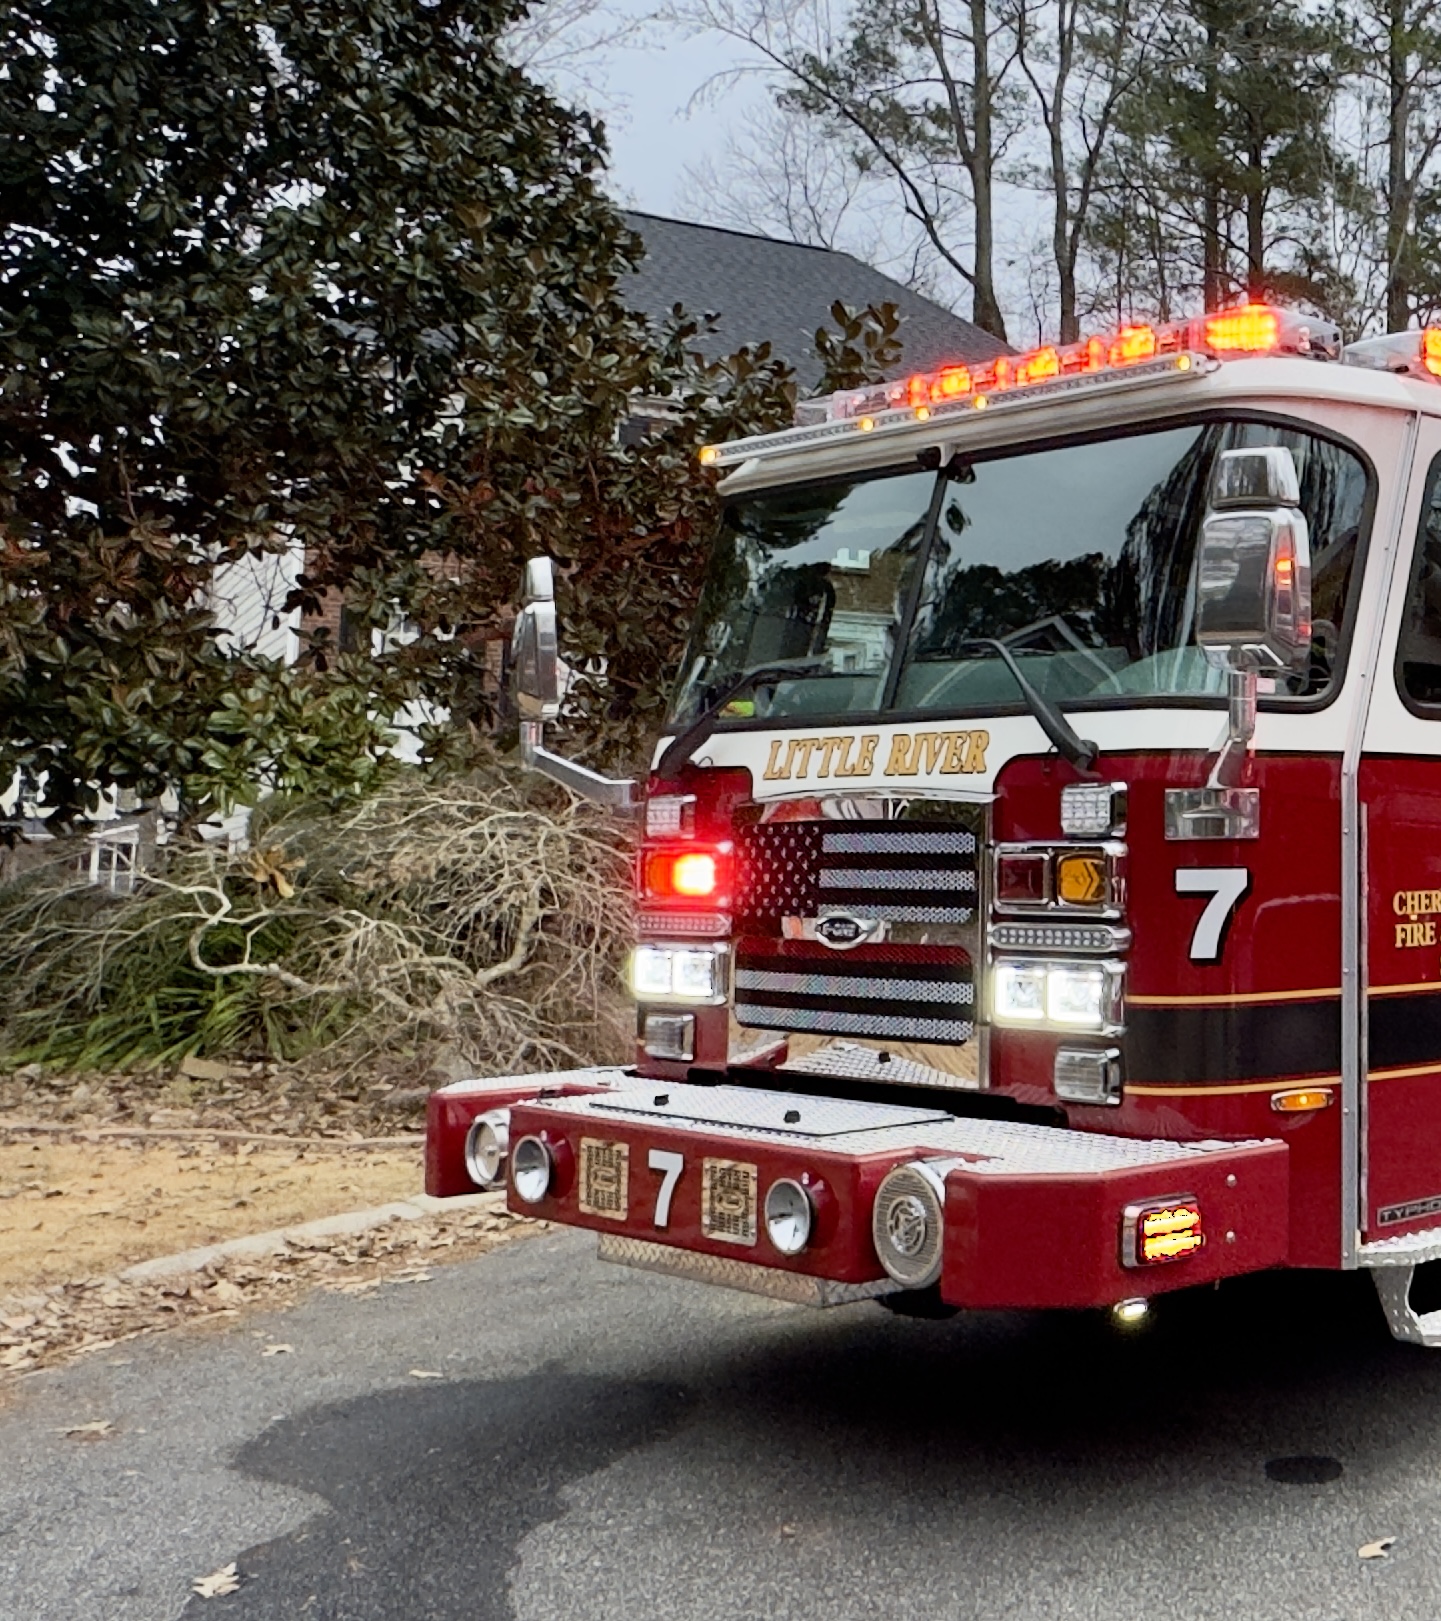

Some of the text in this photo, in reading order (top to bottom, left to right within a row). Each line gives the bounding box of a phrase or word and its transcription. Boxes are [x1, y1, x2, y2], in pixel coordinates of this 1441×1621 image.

[763, 729, 990, 780] LITTLE RIVER
[1175, 867, 1249, 960] 7
[1395, 921, 1437, 948] FIRE
[648, 1149, 684, 1228] 7
